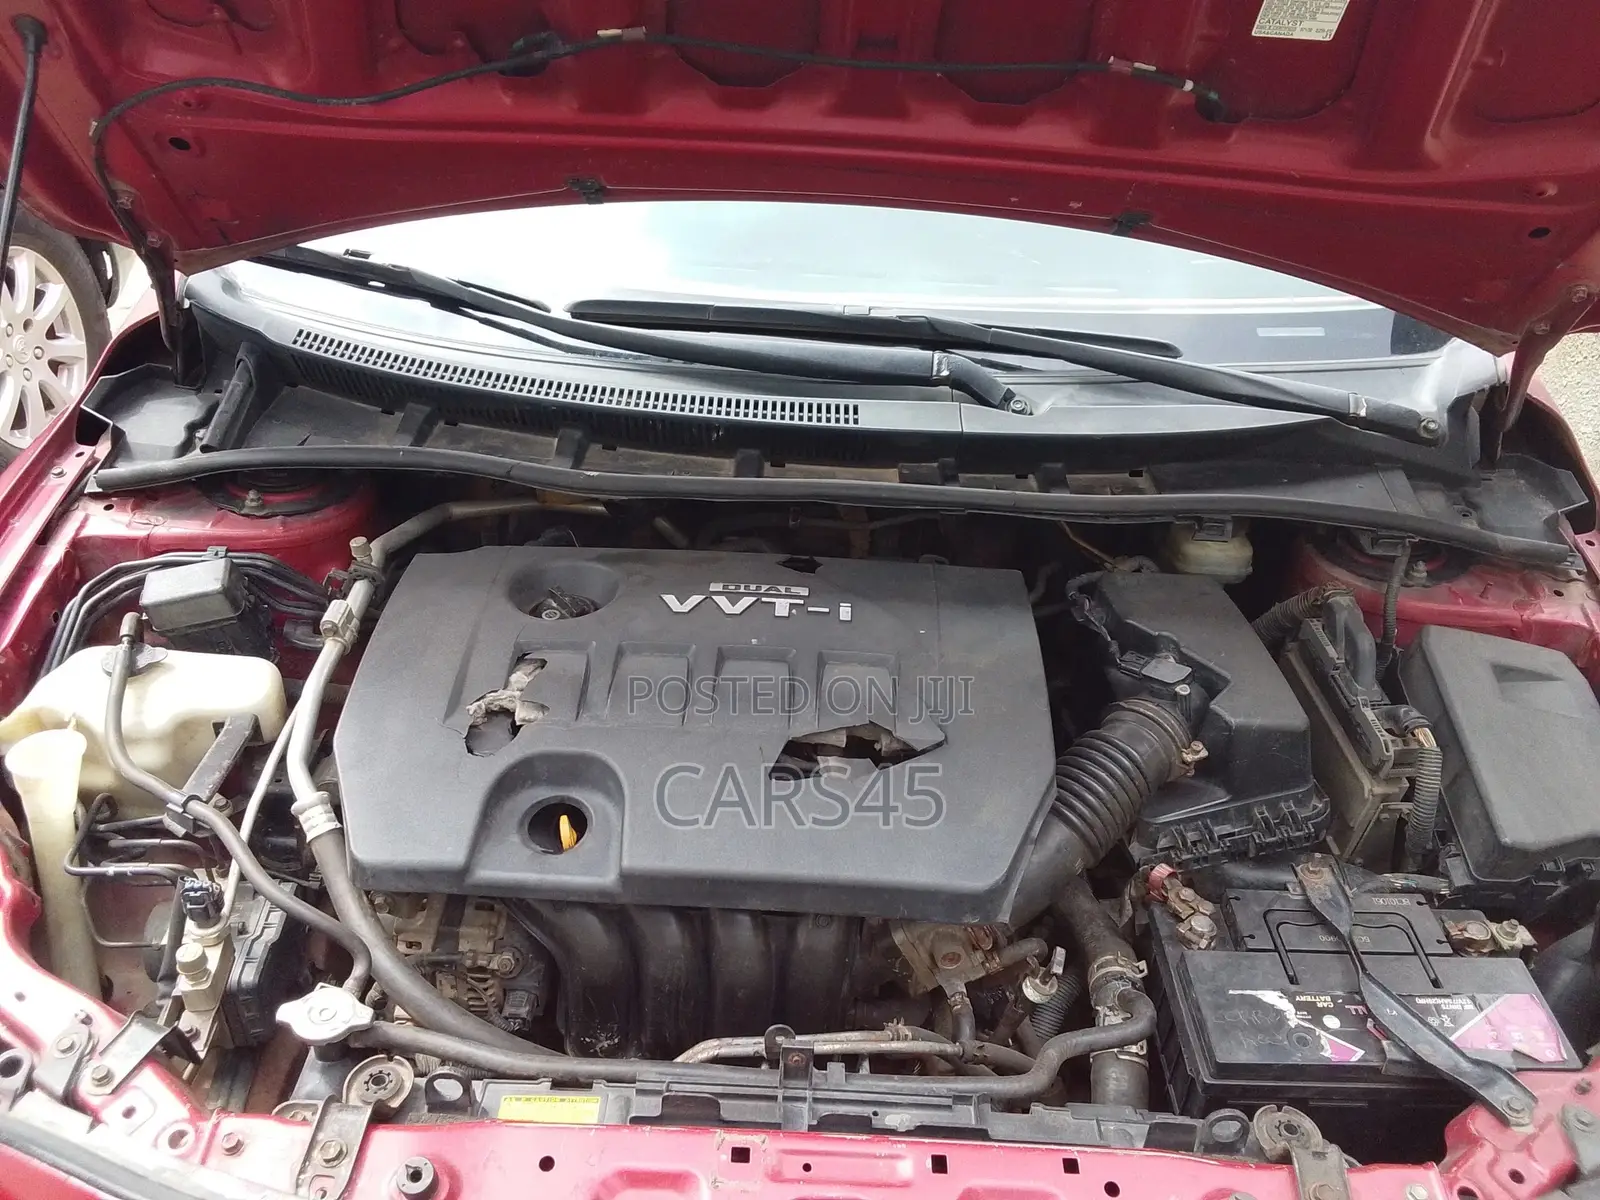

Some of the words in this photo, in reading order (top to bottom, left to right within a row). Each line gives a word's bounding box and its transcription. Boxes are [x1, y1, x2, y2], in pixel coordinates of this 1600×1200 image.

[1258, 18, 1304, 27] CATALYST
[719, 583, 803, 595] DUAL
[660, 594, 852, 621] VVT-i
[1295, 994, 1332, 1002] BATTERY
